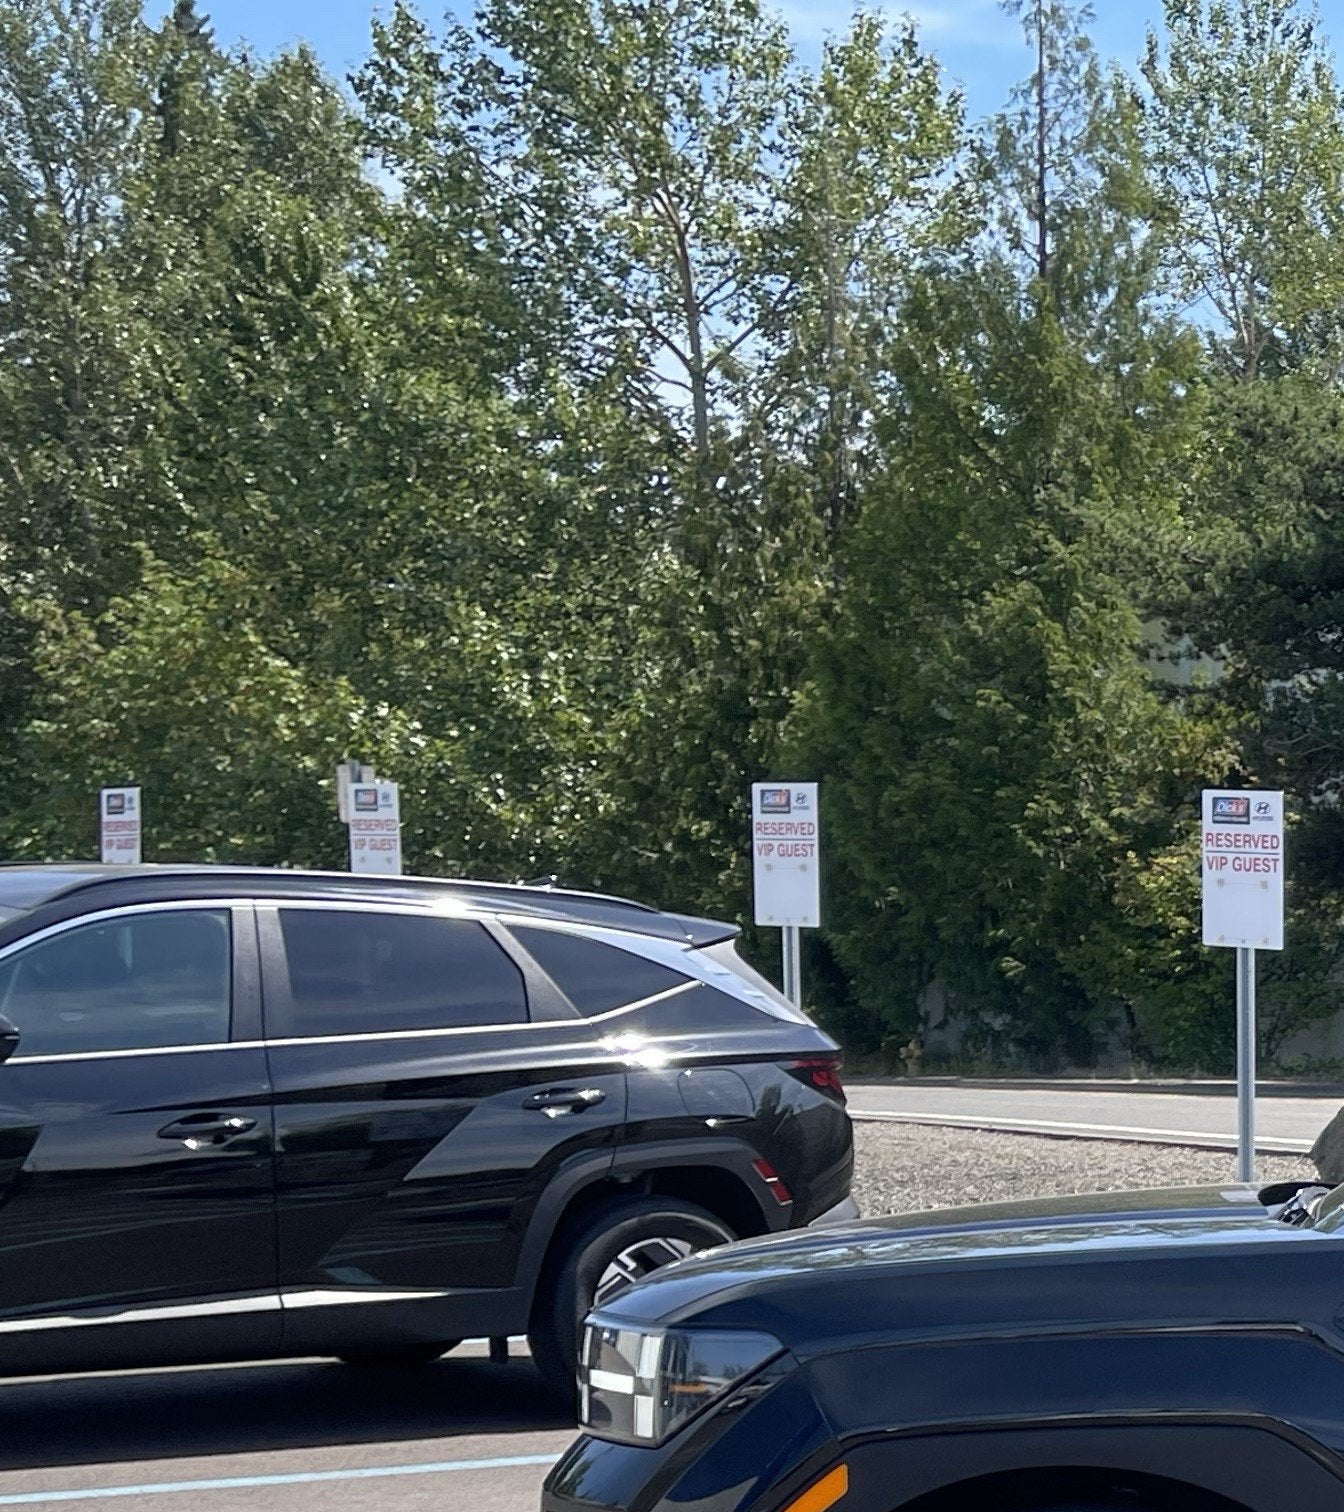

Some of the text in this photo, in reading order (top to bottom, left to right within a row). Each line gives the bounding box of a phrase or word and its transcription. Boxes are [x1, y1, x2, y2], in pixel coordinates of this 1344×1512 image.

[755, 822, 815, 836] RESERVED
[1205, 833, 1280, 849] RESERVED
[757, 843, 815, 857] VIP GUEST
[1206, 856, 1280, 873] VIP GUEST
